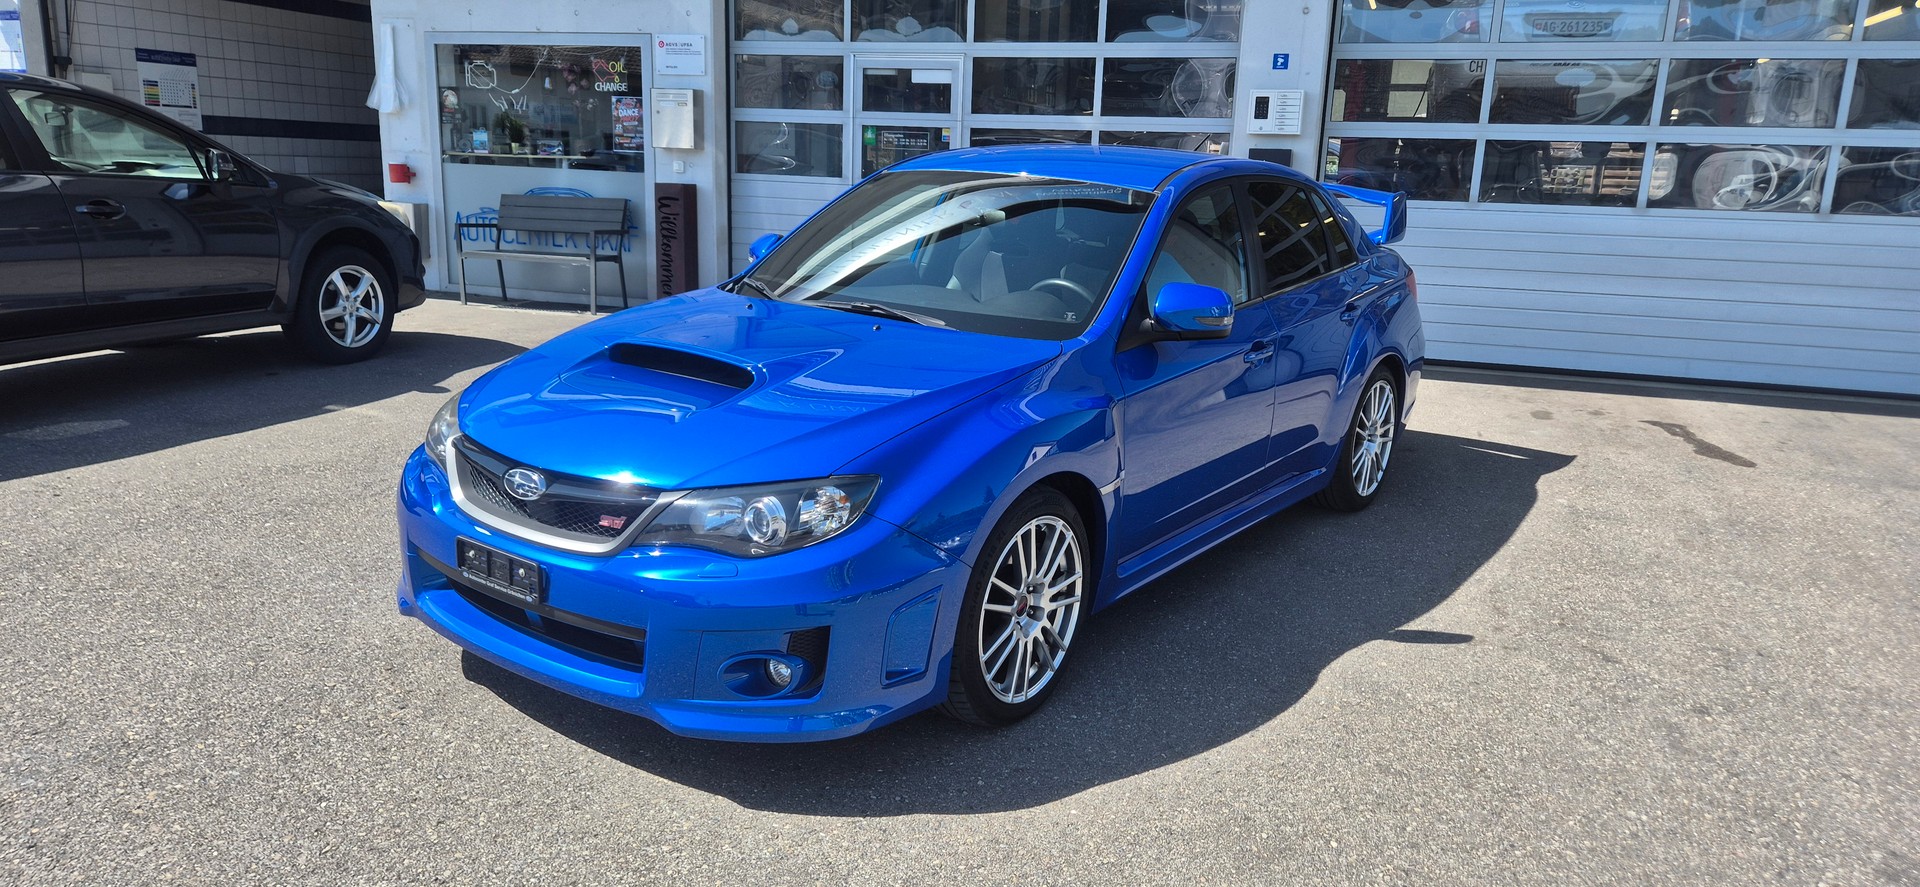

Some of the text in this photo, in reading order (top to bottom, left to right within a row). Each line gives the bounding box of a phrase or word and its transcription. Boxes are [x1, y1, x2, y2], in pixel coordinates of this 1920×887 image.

[609, 61, 627, 73] OIL
[1469, 60, 1483, 73] CH
[594, 82, 628, 92] CHANGE
[618, 108, 639, 117] DANCE
